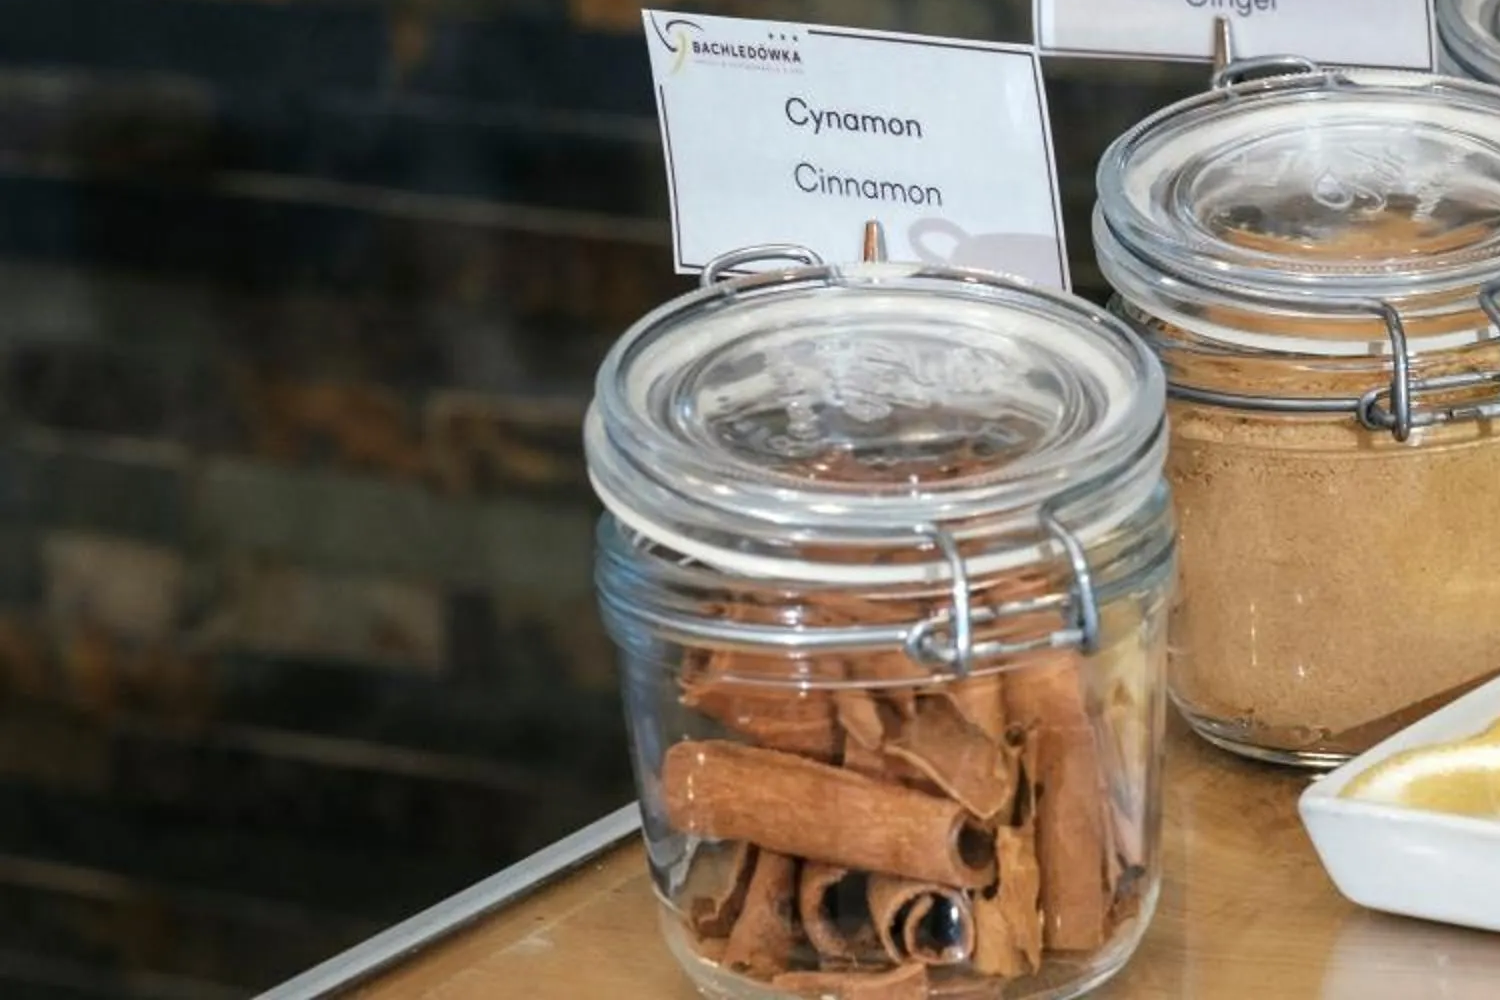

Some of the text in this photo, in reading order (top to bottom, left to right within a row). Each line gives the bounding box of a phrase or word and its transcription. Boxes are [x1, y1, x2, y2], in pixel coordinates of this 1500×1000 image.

[692, 40, 802, 63] BACHLEDÓWKA
[785, 97, 923, 138] Cynamon
[794, 162, 943, 207] Cinnamon
